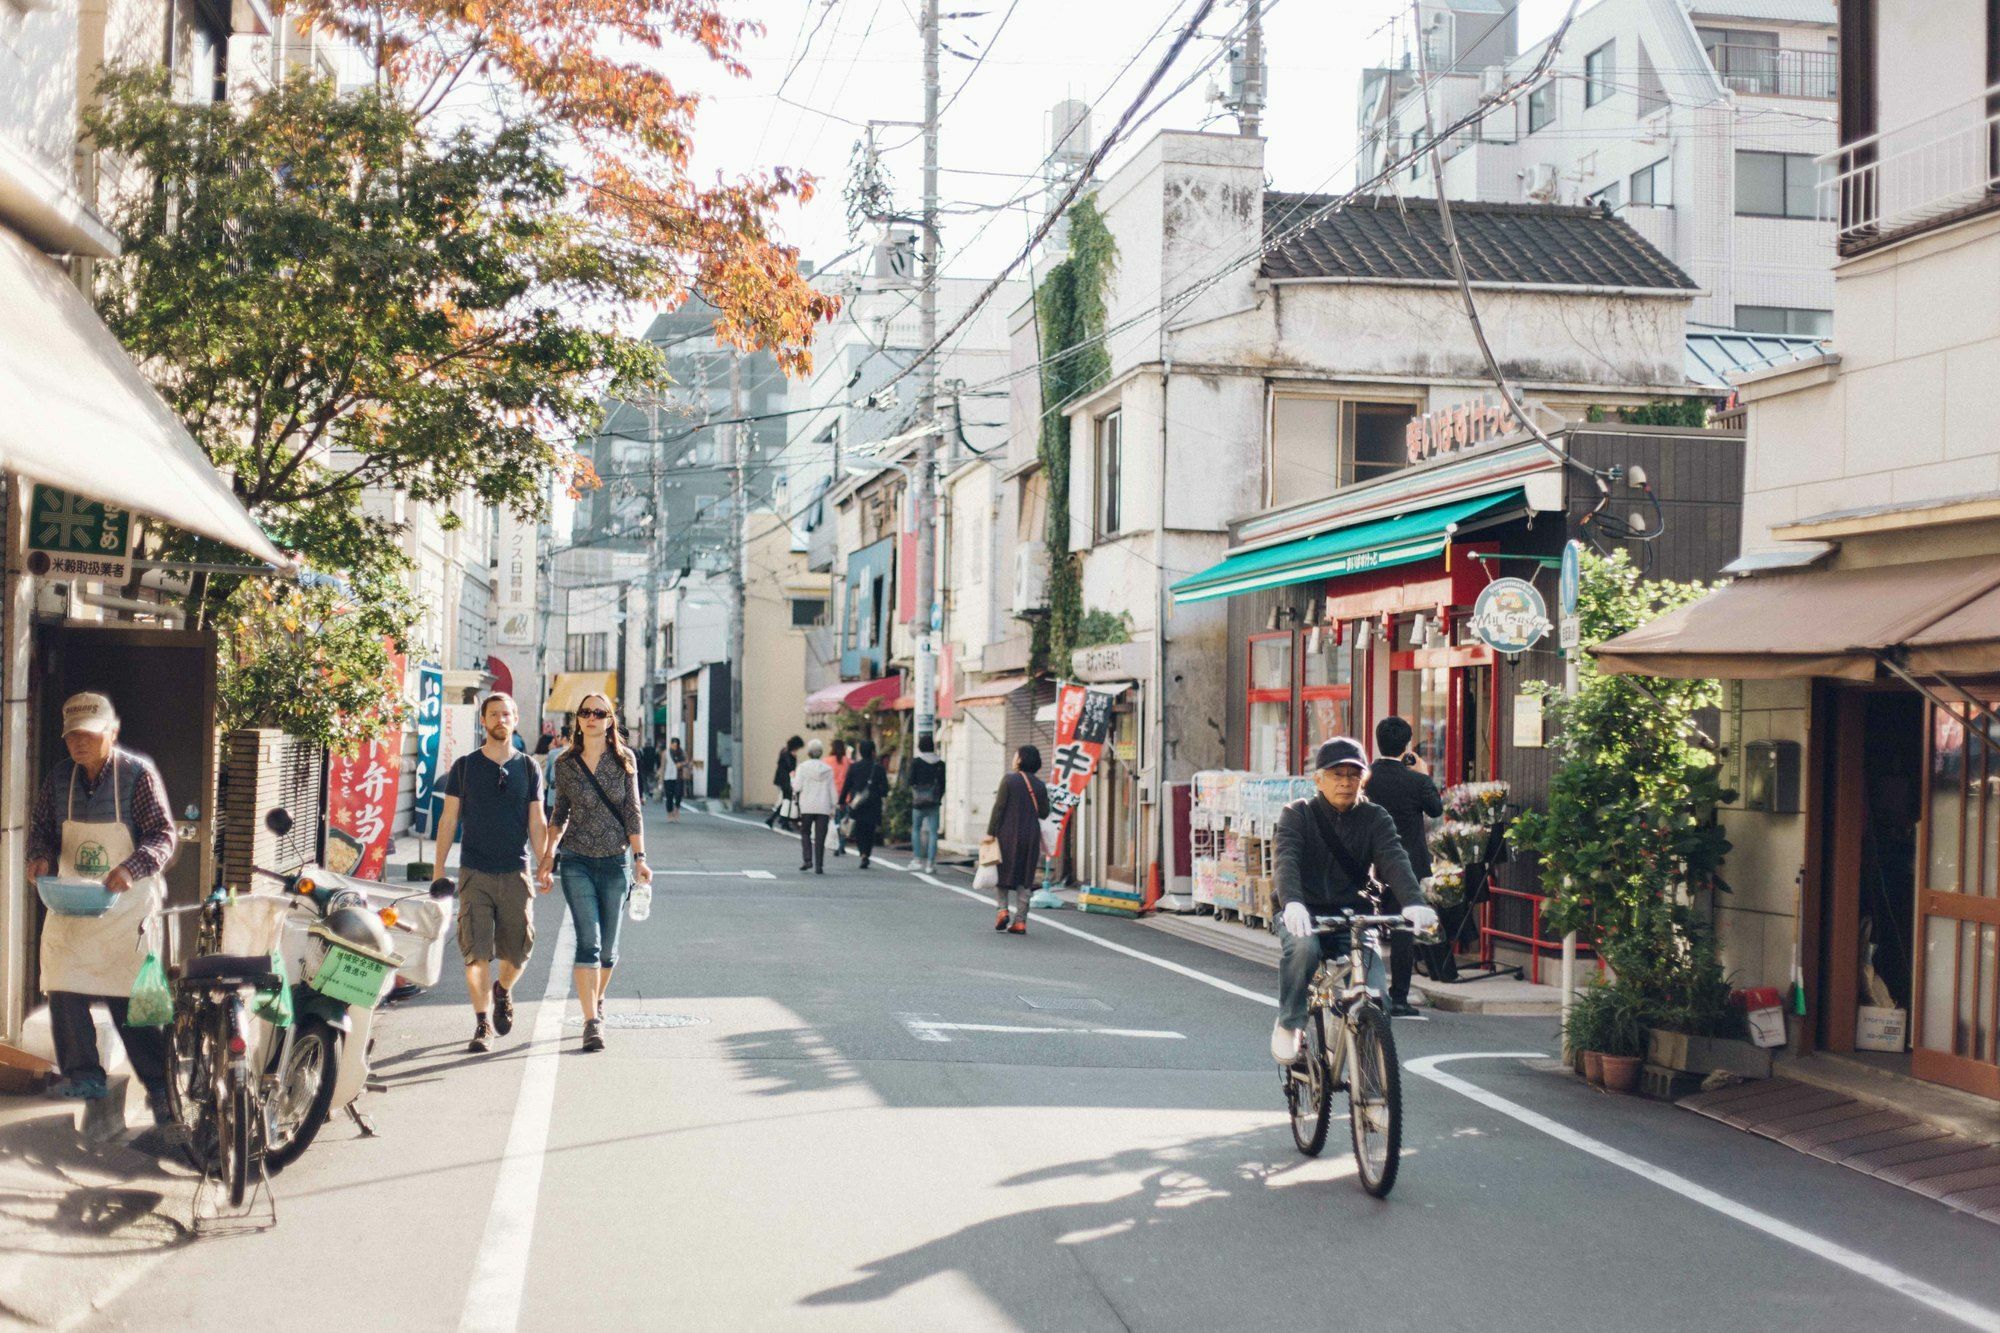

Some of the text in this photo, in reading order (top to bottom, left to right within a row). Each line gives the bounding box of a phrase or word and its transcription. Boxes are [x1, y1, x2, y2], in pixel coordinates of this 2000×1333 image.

[1406, 394, 1516, 465] まいばすけっと
[52, 557, 125, 578] 米穀取扱業者
[415, 676, 440, 800] おでん
